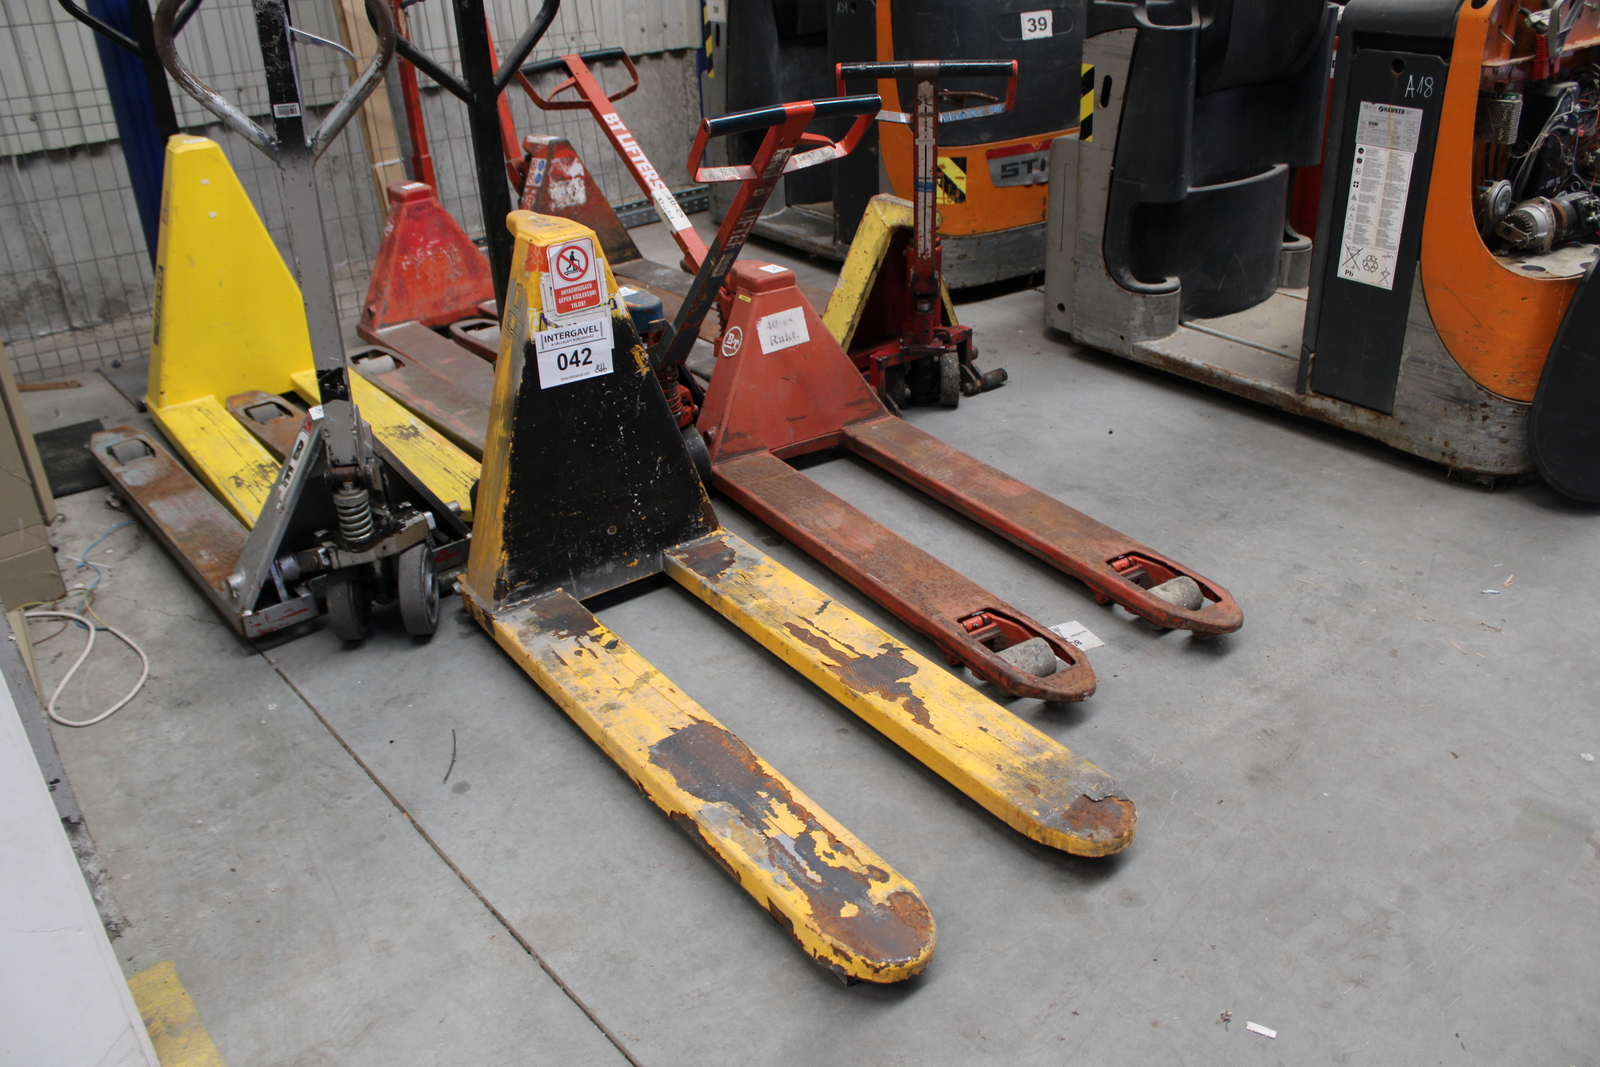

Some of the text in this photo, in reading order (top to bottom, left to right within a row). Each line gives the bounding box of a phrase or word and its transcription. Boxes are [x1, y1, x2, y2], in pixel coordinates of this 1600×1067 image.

[1027, 16, 1048, 33] 39
[1404, 74, 1434, 98] A18
[1382, 106, 1406, 115] HAWKER
[602, 113, 667, 191] BT LIFTERS
[1344, 269, 1354, 278] Pb
[571, 300, 587, 309] TILOS!
[544, 325, 599, 343] INTERGAVEL
[556, 347, 593, 371] 042
